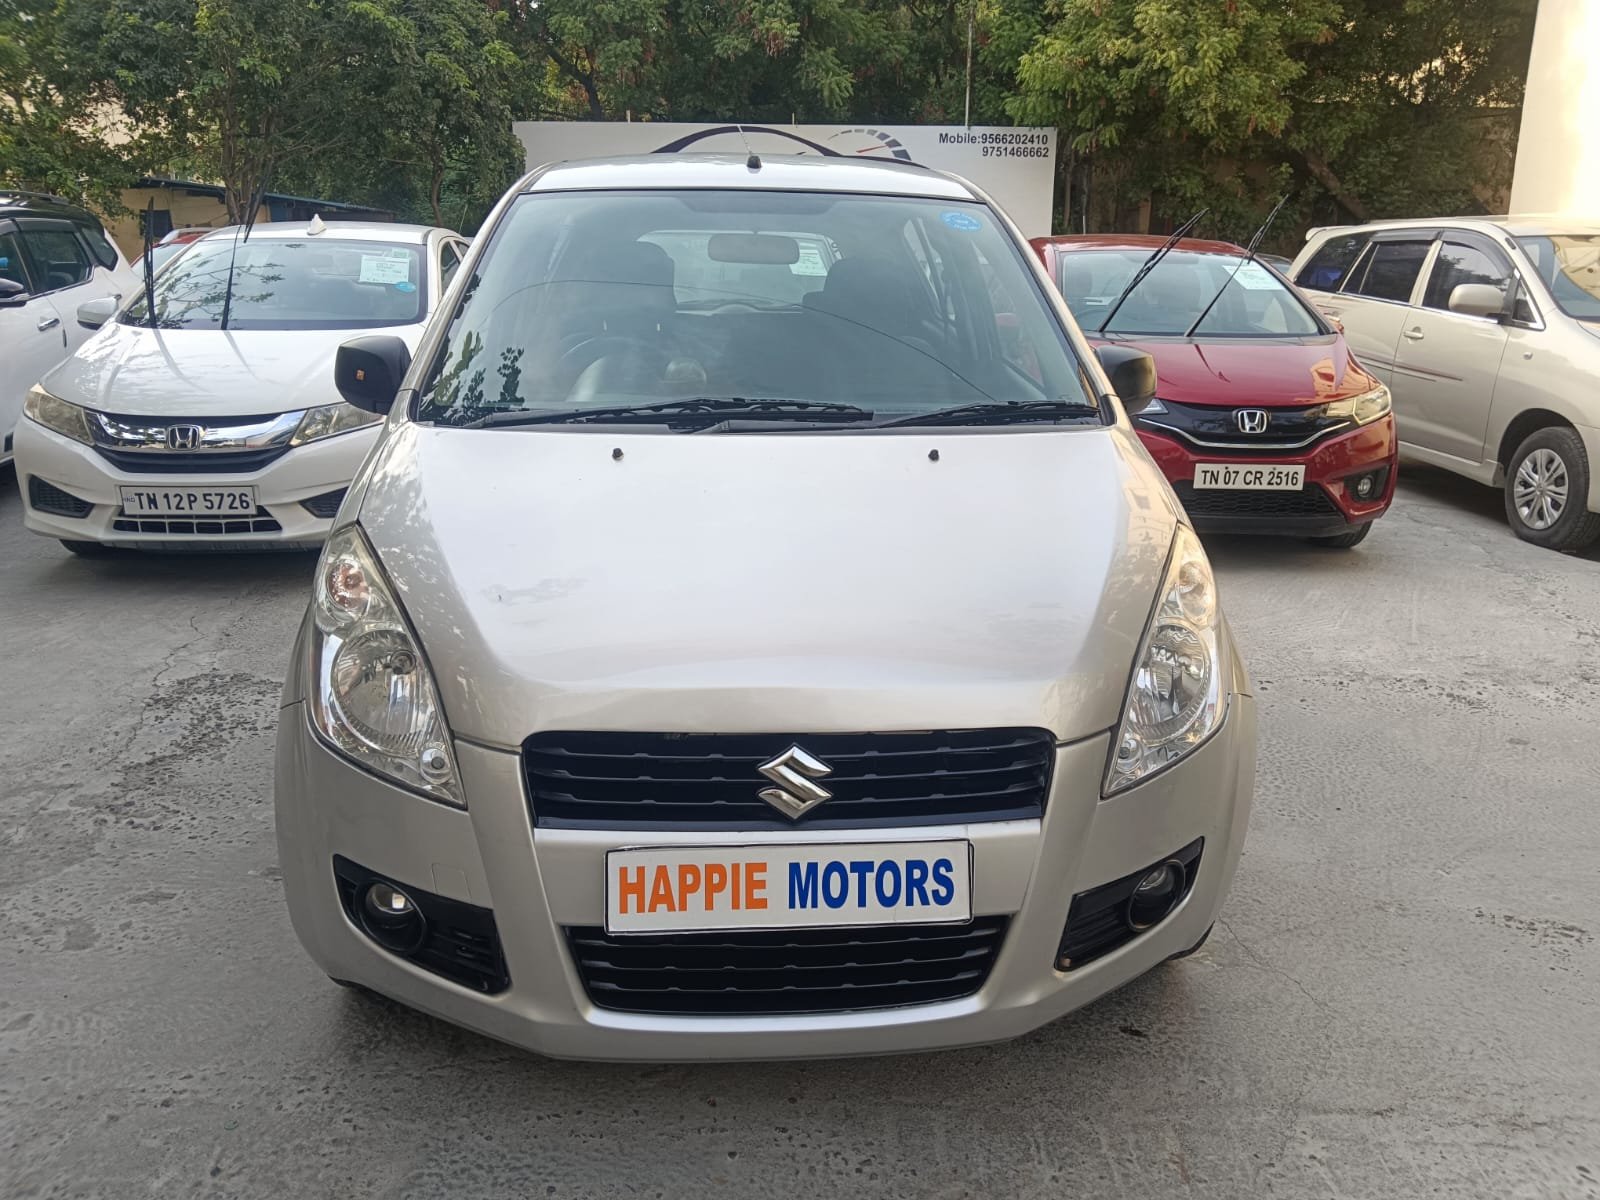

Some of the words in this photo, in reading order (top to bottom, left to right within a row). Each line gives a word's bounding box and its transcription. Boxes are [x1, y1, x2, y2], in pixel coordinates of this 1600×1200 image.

[982, 146, 1049, 158] 9751466662
[1201, 470, 1220, 486] TN
[1223, 470, 1240, 486] 07
[1243, 470, 1264, 486] CR
[1266, 471, 1299, 486] 2516
[134, 493, 158, 510] TN
[202, 493, 250, 510] 5726
[618, 862, 769, 915] HAPPIE
[788, 858, 955, 910] MOTORS
